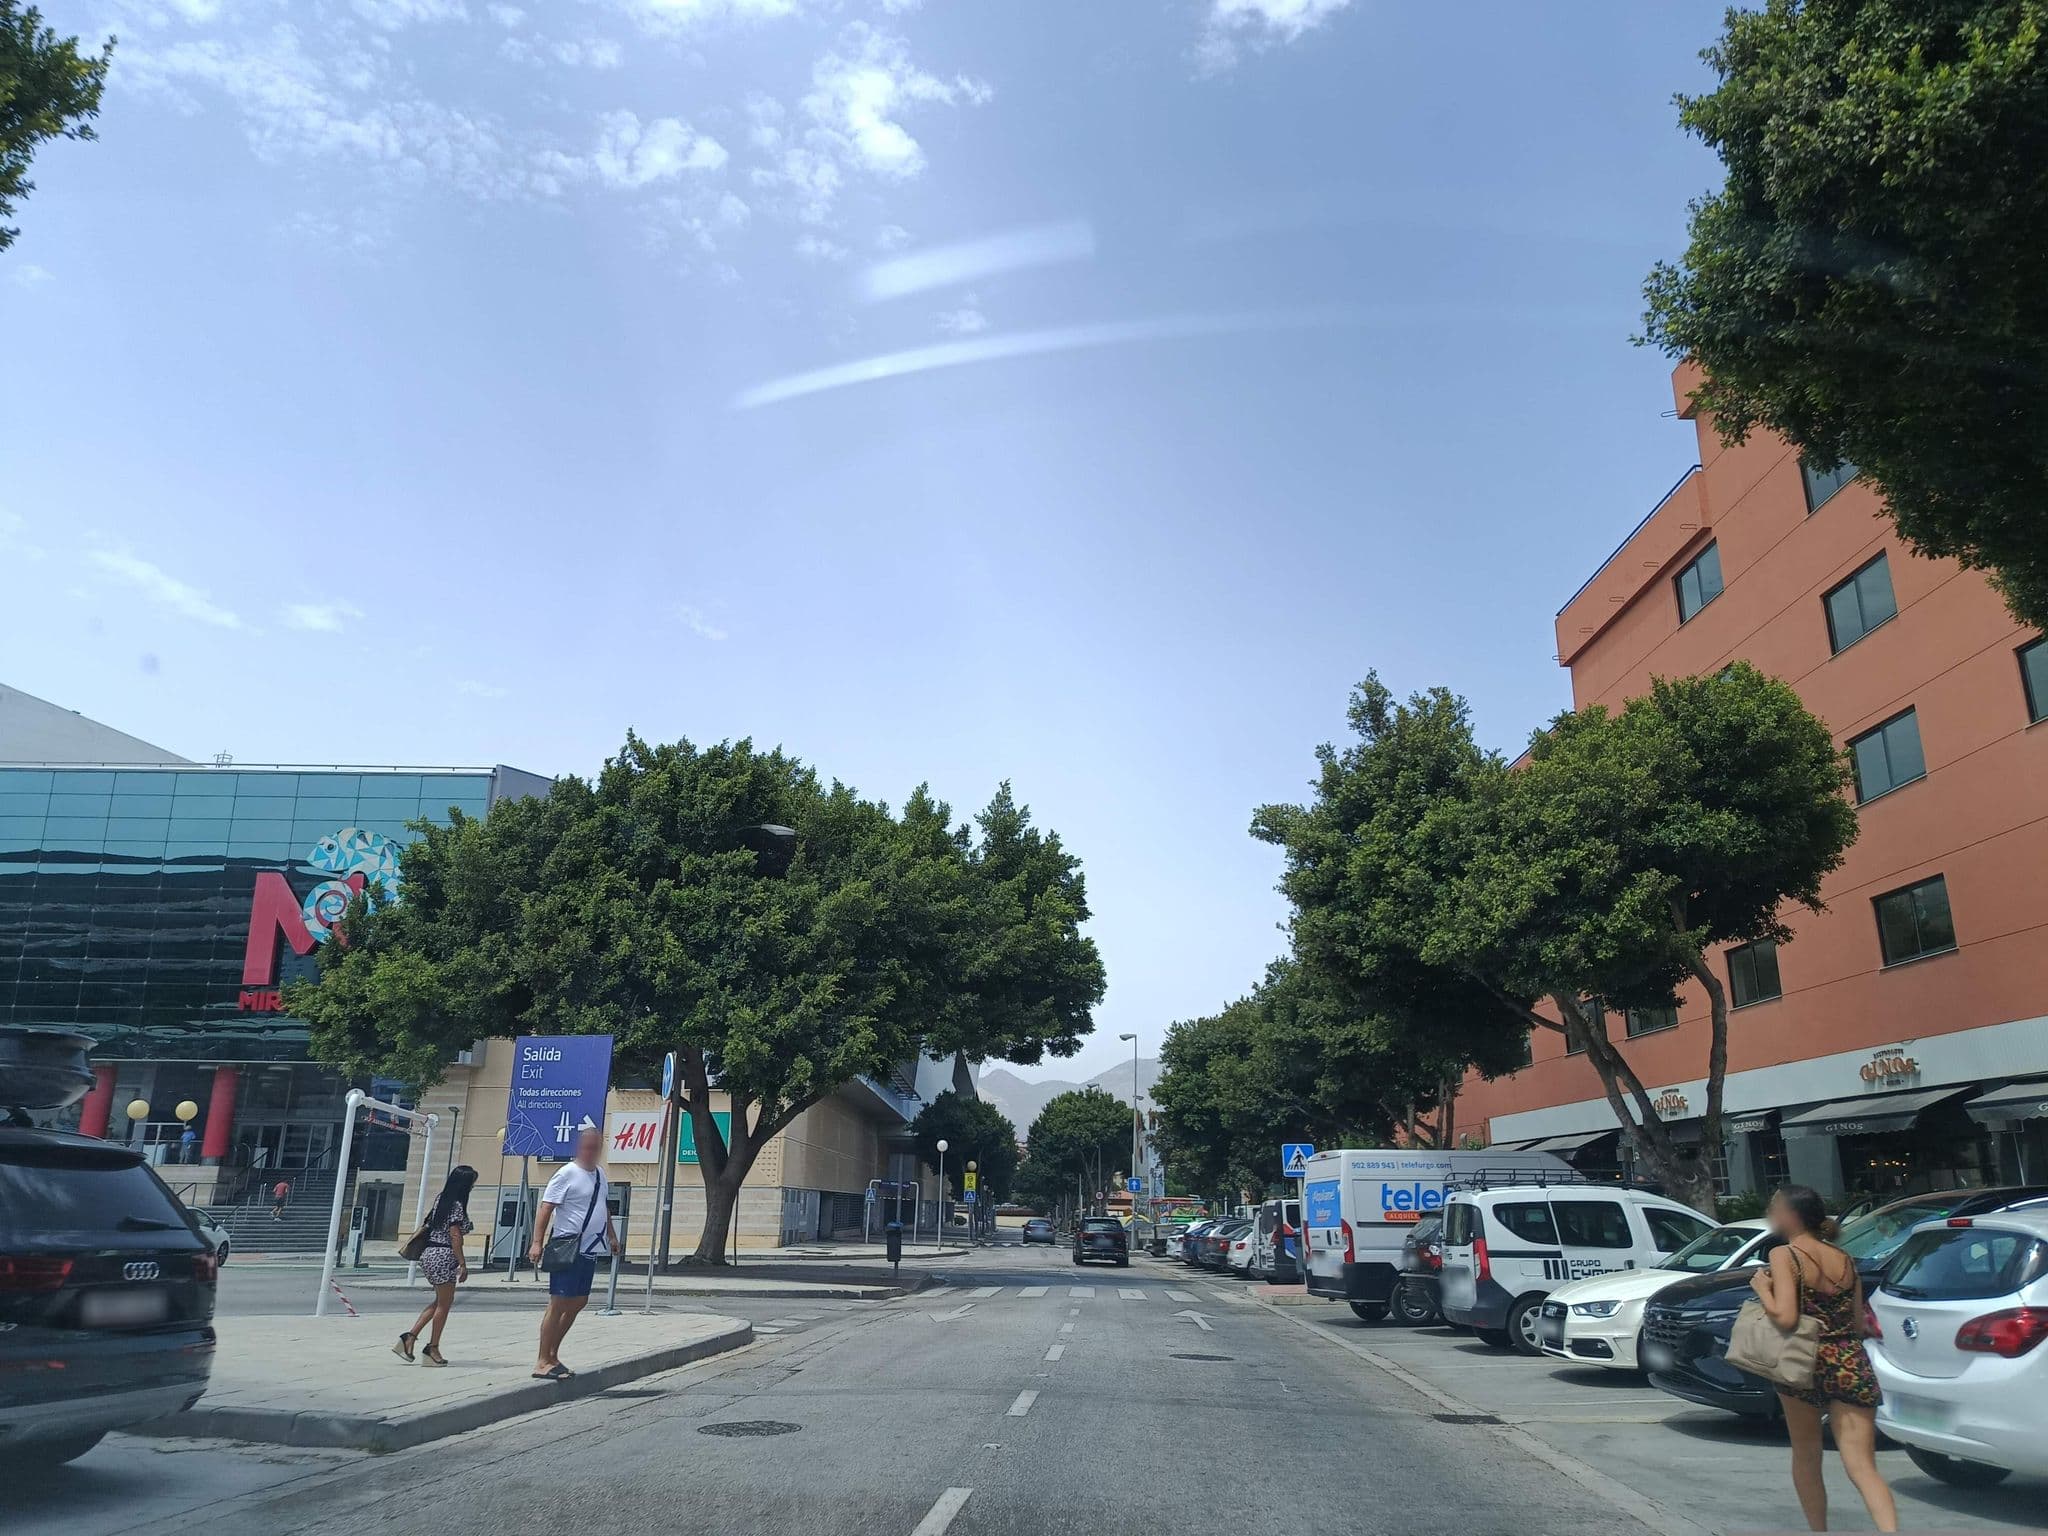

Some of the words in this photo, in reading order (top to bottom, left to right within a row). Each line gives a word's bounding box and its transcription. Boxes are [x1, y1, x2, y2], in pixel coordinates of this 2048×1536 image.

[523, 1047, 562, 1061] Salida
[521, 1064, 544, 1079] Exit
[519, 1087, 540, 1097] Todas
[540, 1087, 582, 1097] direcciones
[517, 1100, 527, 1109] All
[528, 1100, 562, 1109] directions
[1825, 1122, 1864, 1132] GINOS
[614, 1122, 657, 1151] H&M
[1570, 1259, 1601, 1267] GRUPO
